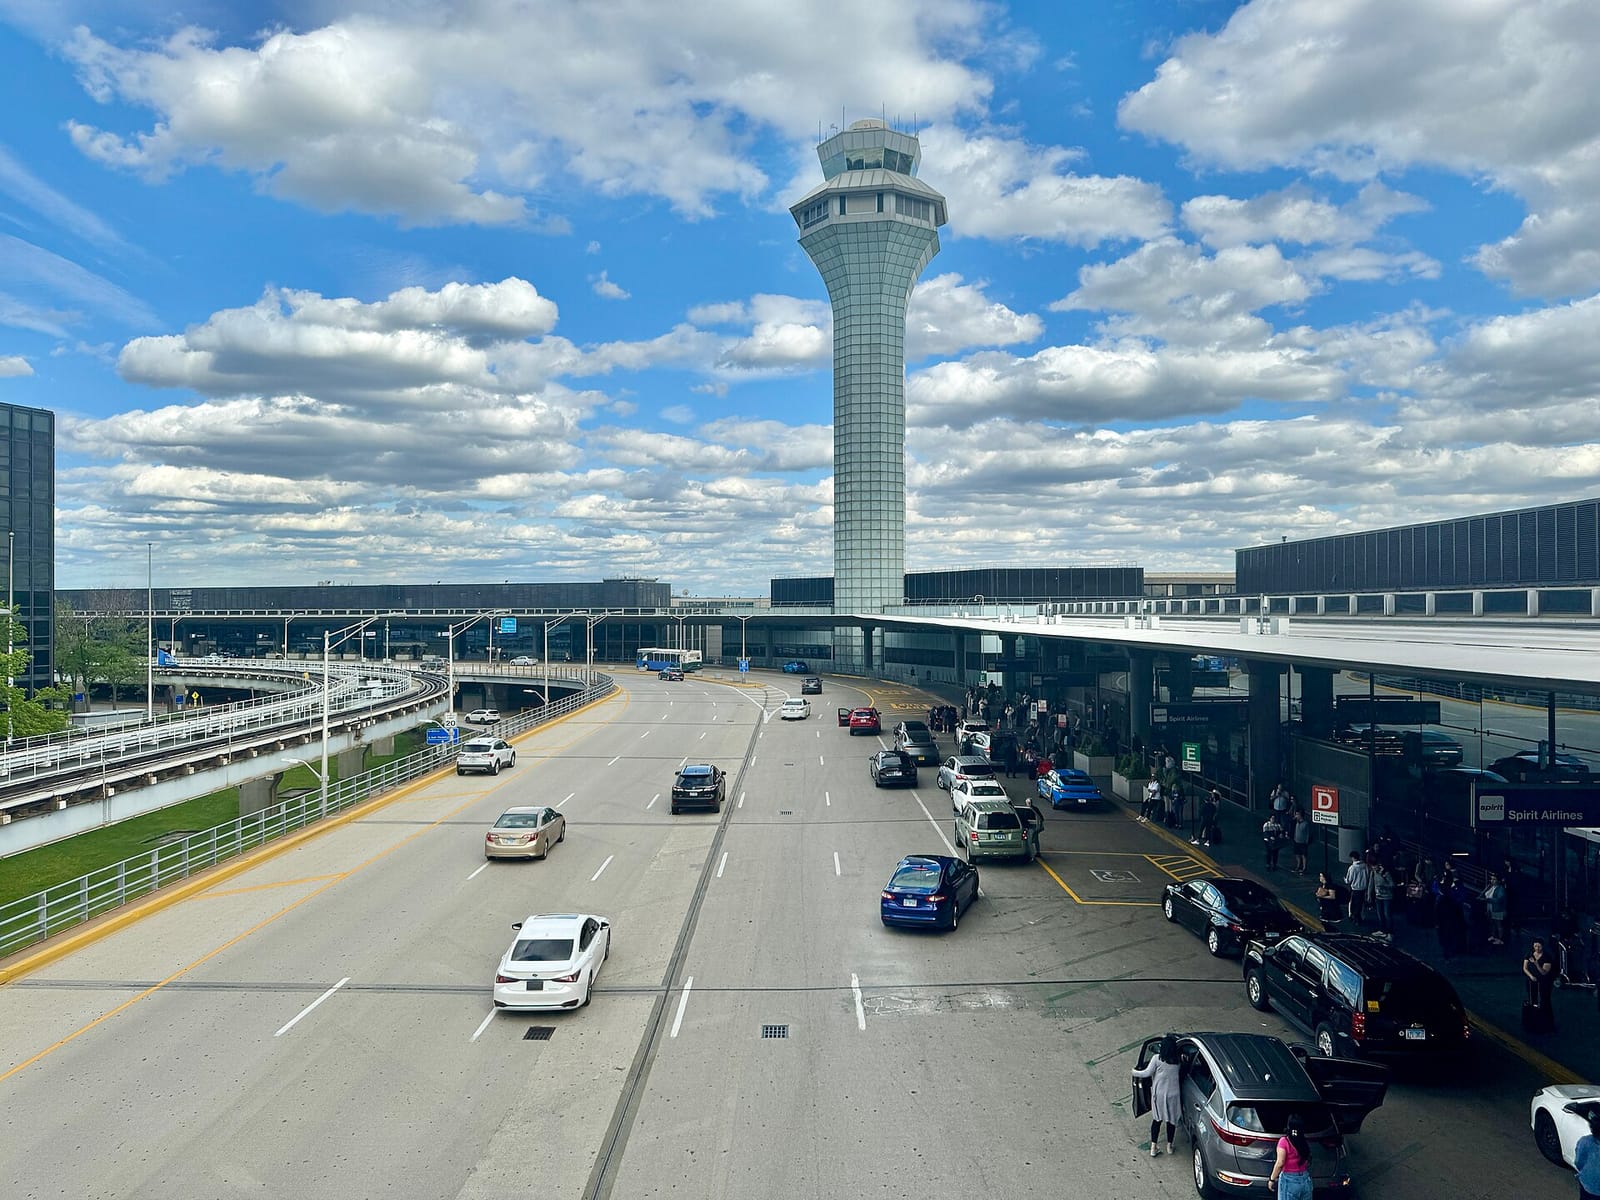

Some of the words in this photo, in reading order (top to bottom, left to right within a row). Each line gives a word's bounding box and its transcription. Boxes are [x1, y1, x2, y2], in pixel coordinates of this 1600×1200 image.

[1186, 714, 1209, 722] Airlines
[1186, 747, 1196, 760] E
[1317, 791, 1333, 809] D
[1480, 804, 1504, 812] spirit
[1508, 810, 1538, 822] Spirit
[1541, 810, 1584, 821] Airlines
